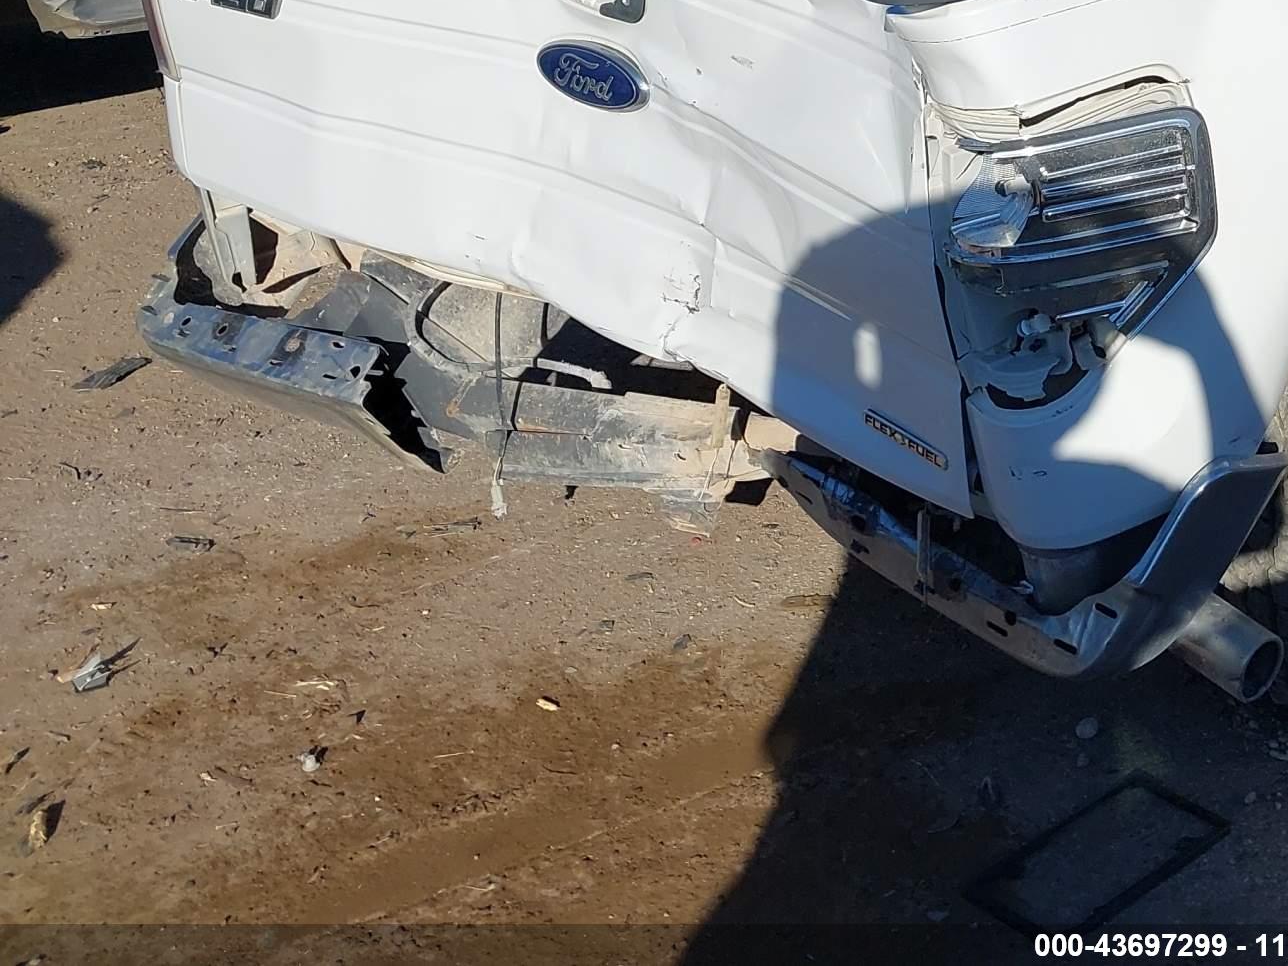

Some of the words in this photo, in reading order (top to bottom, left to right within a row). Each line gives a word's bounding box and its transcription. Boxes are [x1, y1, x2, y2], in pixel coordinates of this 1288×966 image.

[553, 52, 615, 102] Ford
[864, 413, 897, 439] FLEX
[907, 438, 944, 469] FUEL
